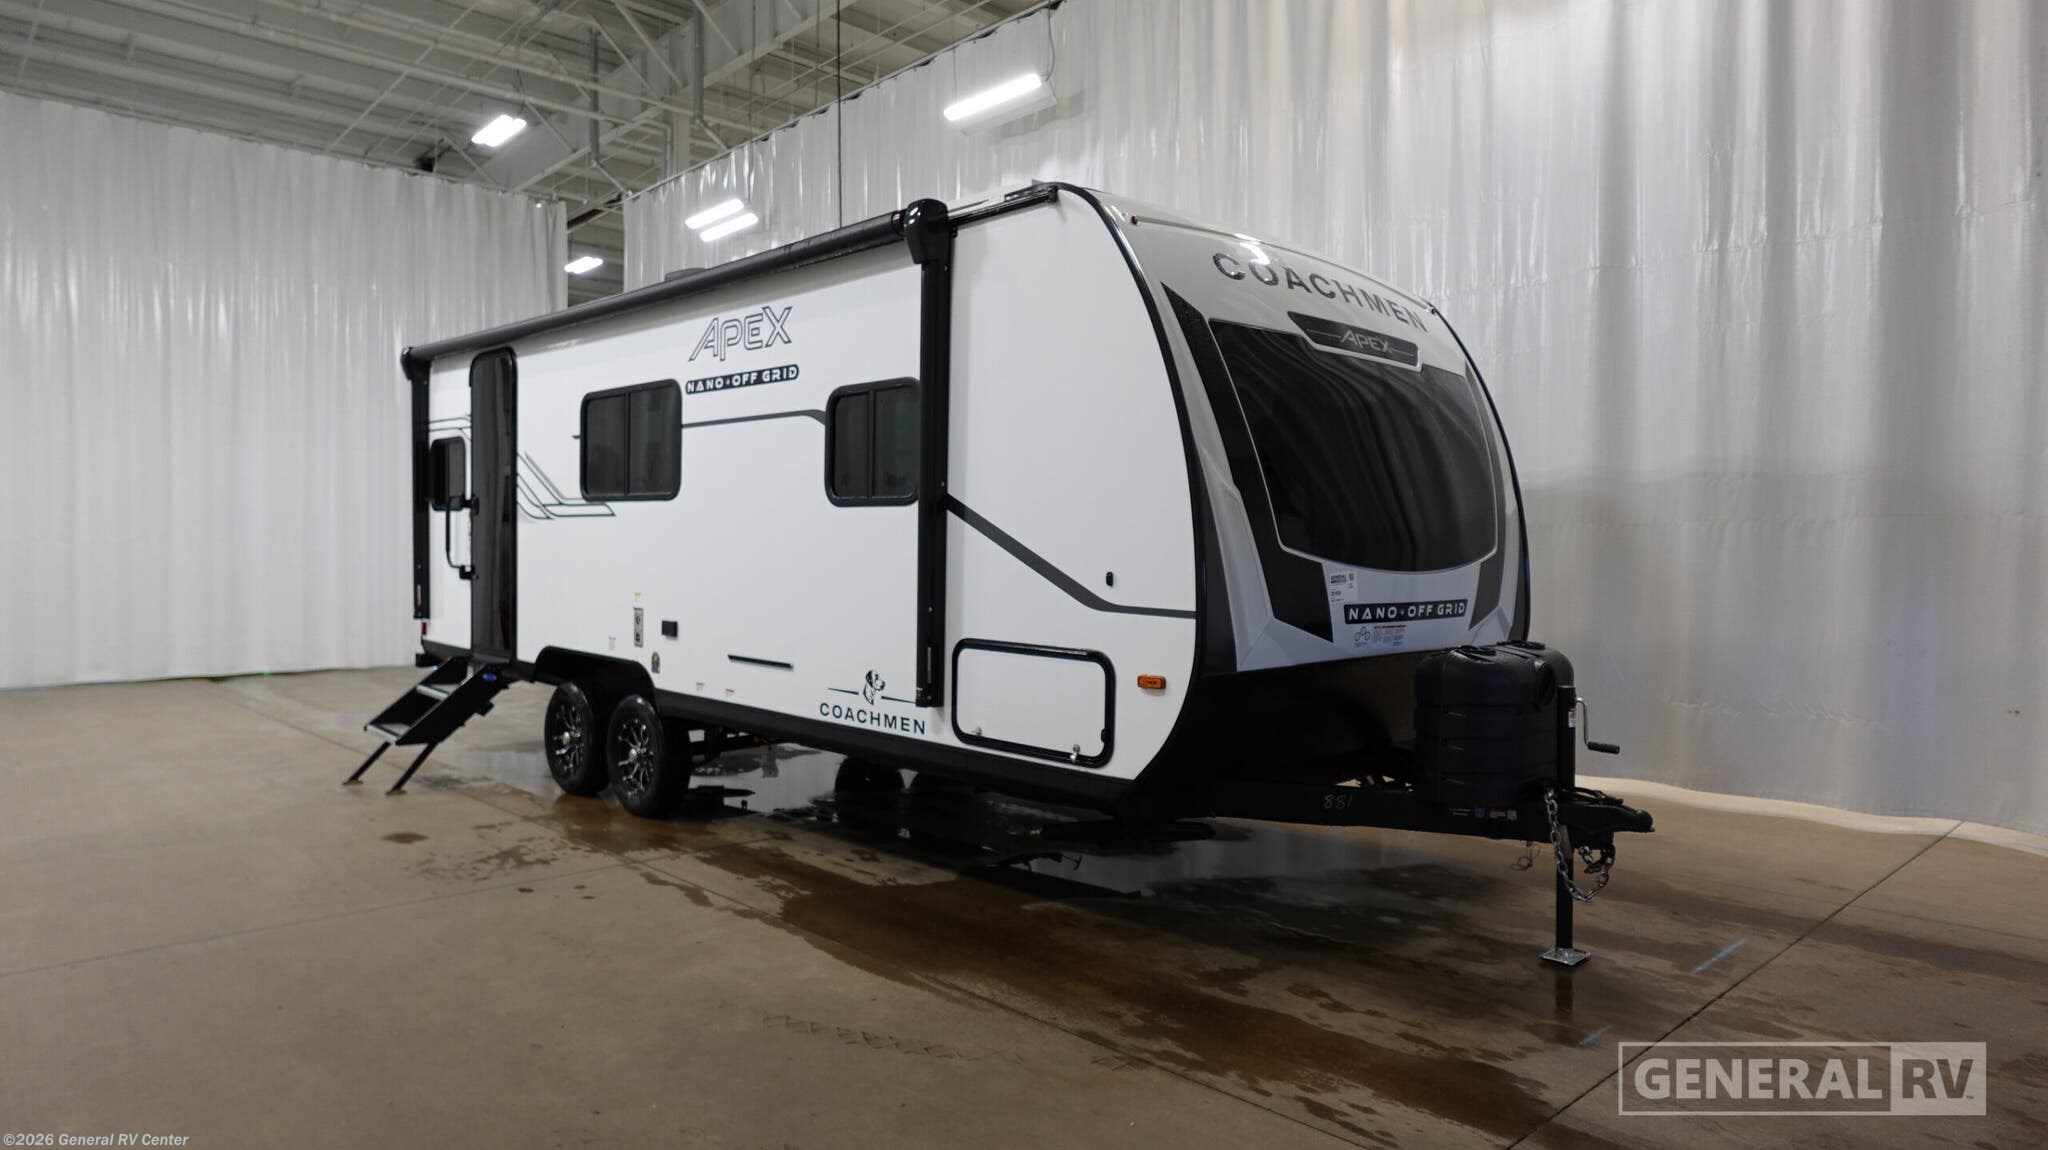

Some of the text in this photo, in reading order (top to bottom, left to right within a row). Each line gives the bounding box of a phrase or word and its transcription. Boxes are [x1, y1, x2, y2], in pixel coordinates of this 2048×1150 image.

[1212, 252, 1428, 332] COACHMEN
[688, 306, 793, 362] APEX
[1339, 329, 1392, 353] APEX
[686, 366, 798, 393] NANO OFF GRID
[1348, 601, 1466, 621] NANO OFF GRID
[819, 702, 926, 735] COACHMEN
